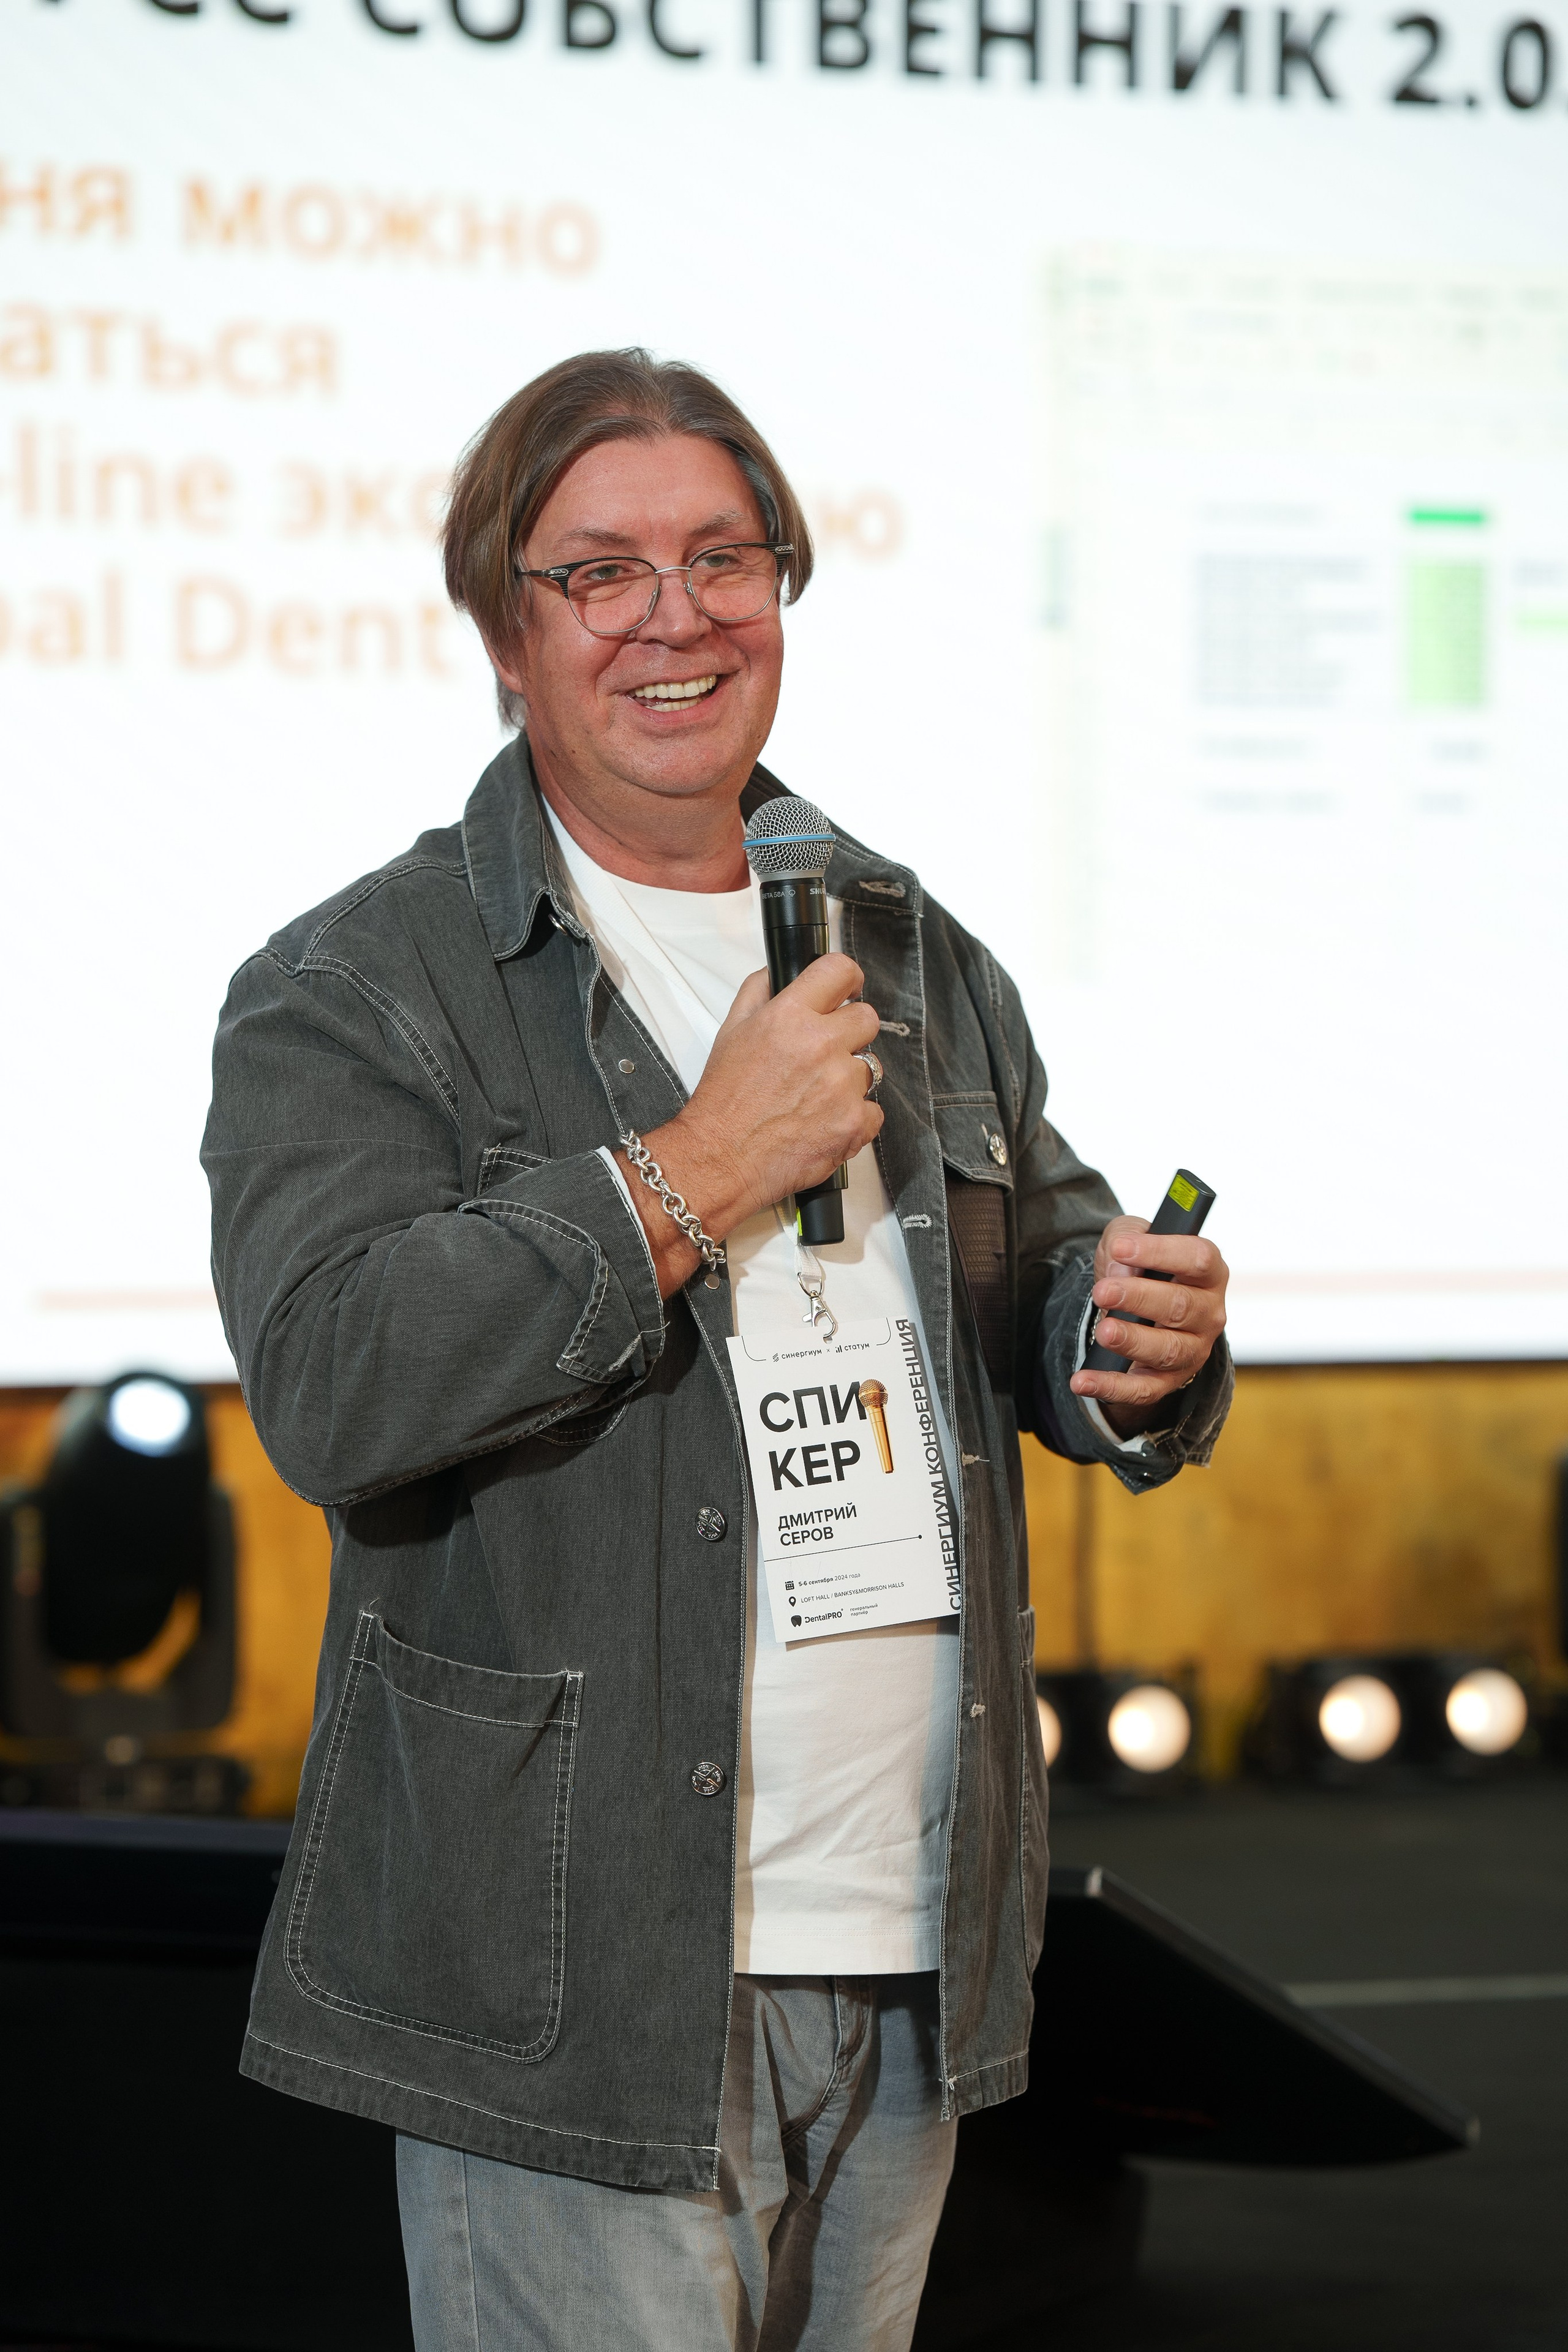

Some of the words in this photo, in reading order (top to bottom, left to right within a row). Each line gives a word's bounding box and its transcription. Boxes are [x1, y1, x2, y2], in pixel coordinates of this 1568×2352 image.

[183, 175, 601, 276] можно
[0, 423, 235, 533] line
[781, 1349, 822, 1359] синергиум
[844, 1343, 870, 1351] статум
[759, 1381, 867, 1433] СПИ
[895, 1318, 944, 1475] КОНФЕРЕНЦИЯ
[768, 1439, 861, 1491] КЕР
[778, 1502, 858, 1531] ДМИТРИЙ
[780, 1526, 834, 1546] СЕРОВ
[930, 1480, 962, 1611] СИНЕРГИУМ
[834, 1584, 887, 1598] BANKSY&MORRISON
